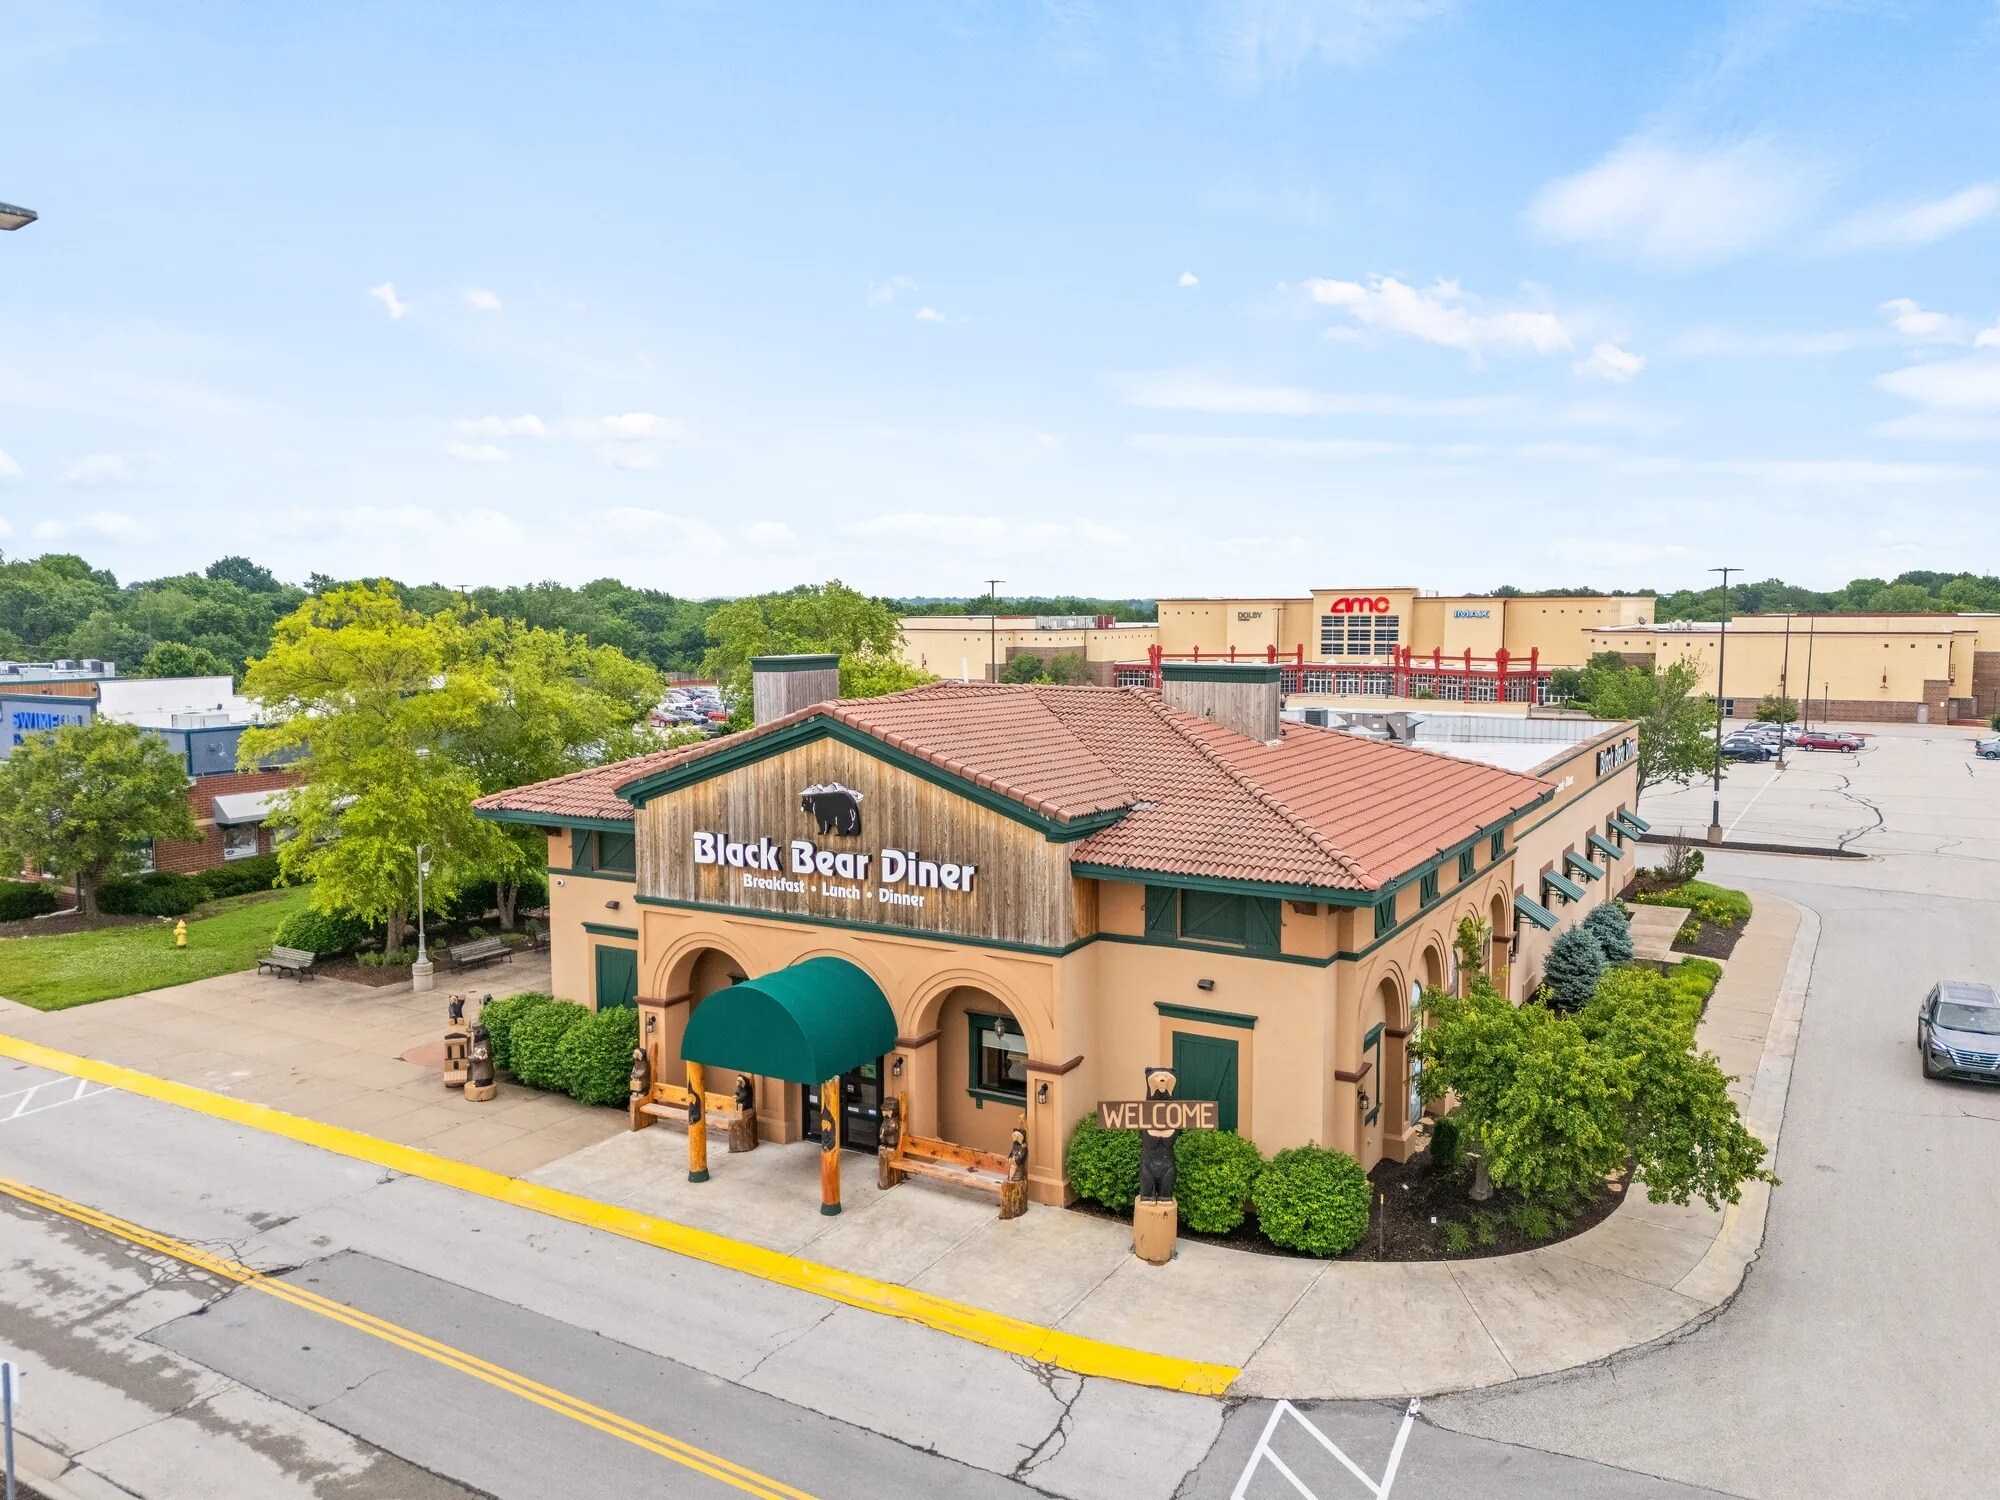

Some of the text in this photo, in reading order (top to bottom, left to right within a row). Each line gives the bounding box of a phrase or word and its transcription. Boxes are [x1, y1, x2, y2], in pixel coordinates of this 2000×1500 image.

[1237, 611, 1262, 619] DOLBY
[1453, 610, 1490, 619] IMAX
[693, 831, 978, 892] Black Bear Diner
[743, 873, 925, 908] Breakfast Lunch Dinner
[1102, 1102, 1215, 1129] WELCOME
